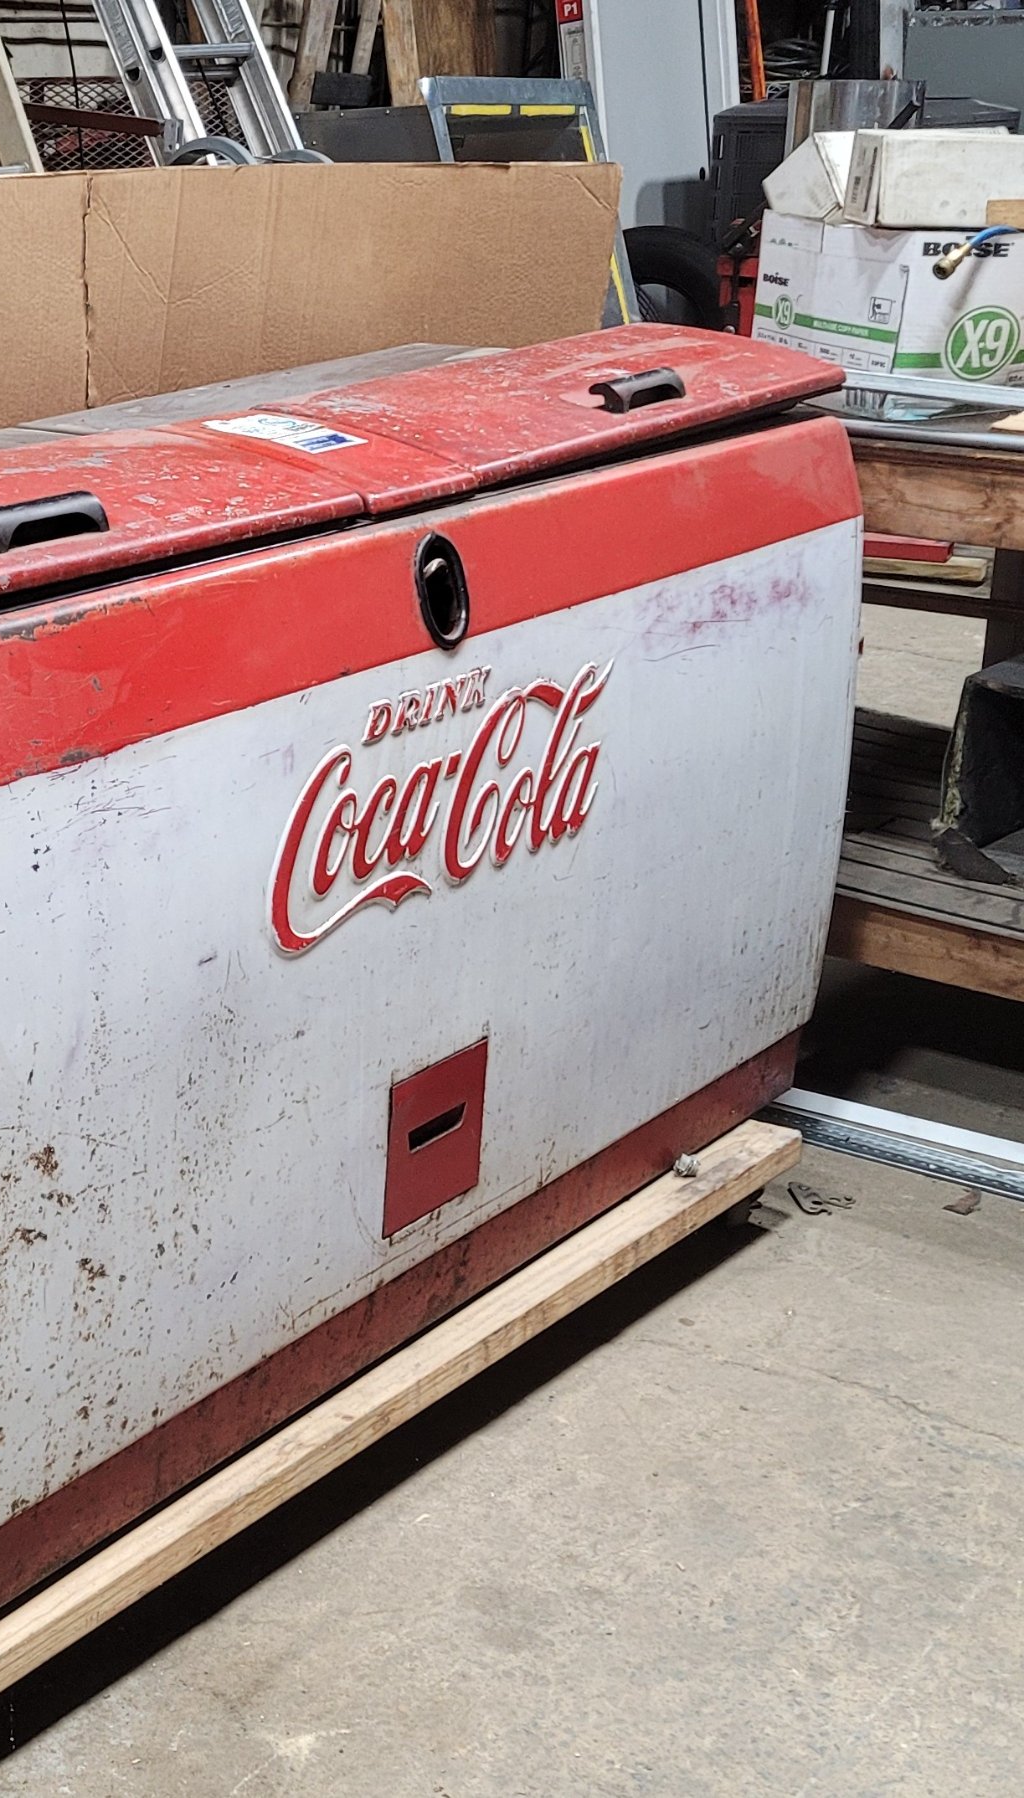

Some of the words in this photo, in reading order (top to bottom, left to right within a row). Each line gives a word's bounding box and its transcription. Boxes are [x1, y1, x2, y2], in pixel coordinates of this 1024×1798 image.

[563, 3, 578, 17] P1
[361, 665, 493, 746] DRINK
[268, 658, 615, 960] Coca-Cola
